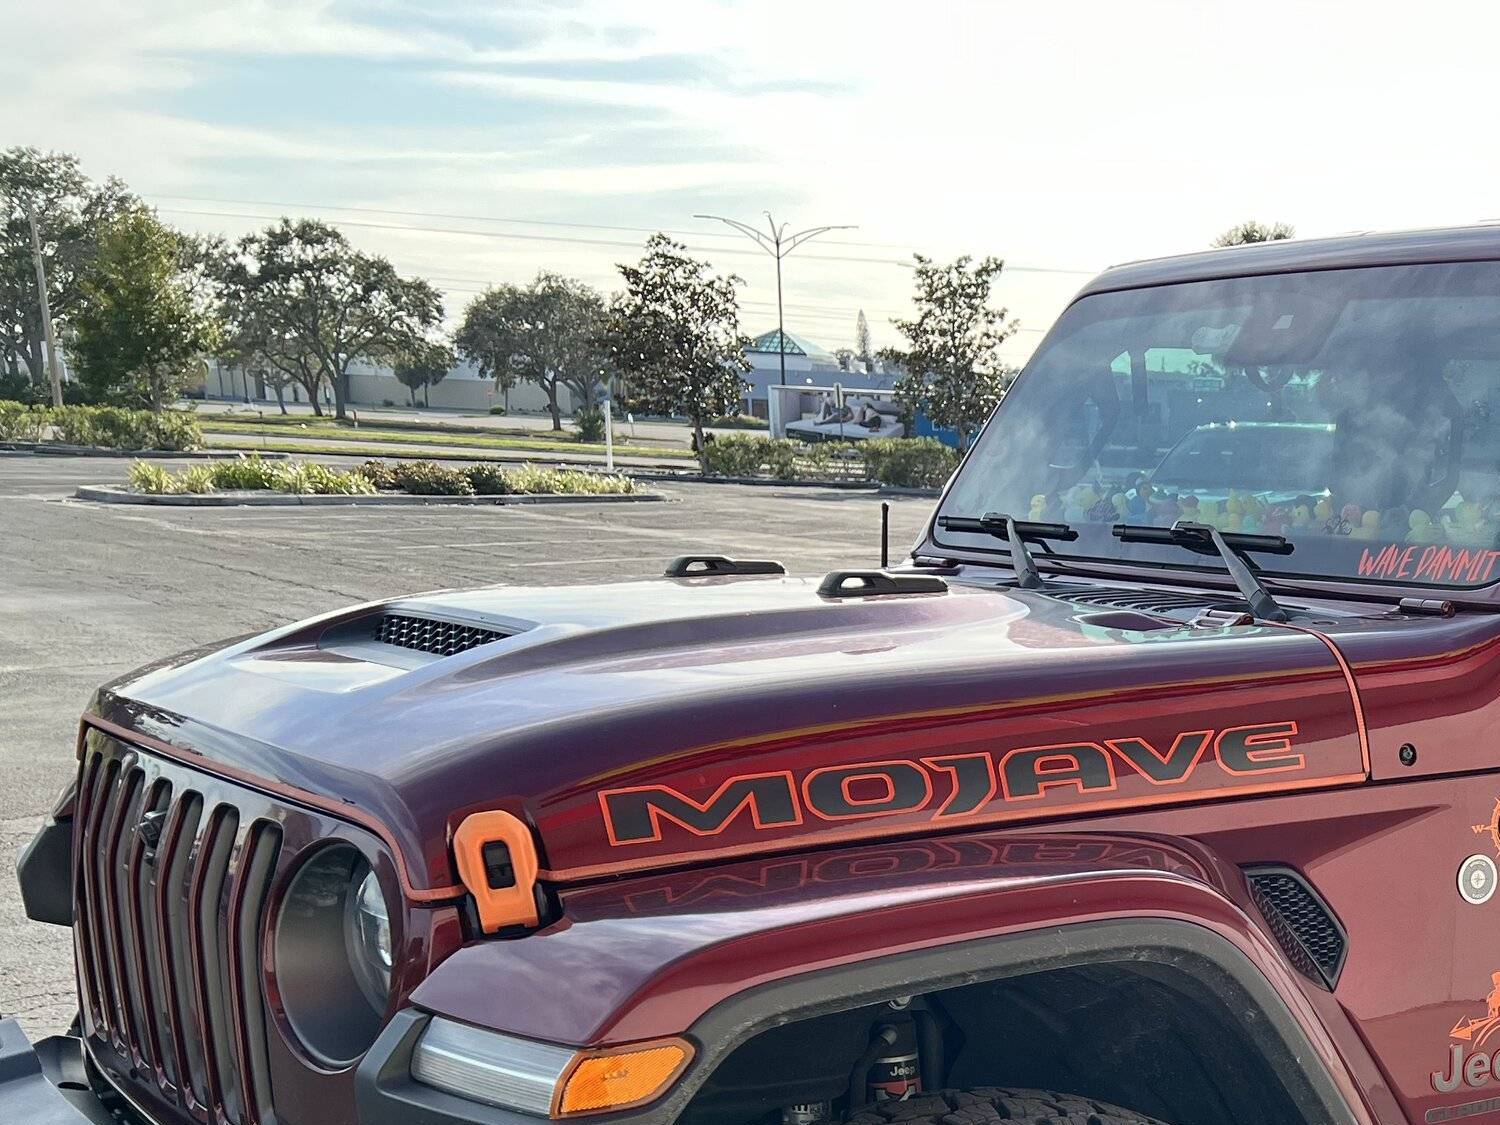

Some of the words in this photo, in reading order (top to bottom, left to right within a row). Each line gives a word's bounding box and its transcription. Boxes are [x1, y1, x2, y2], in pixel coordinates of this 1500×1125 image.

[1358, 543, 1418, 579] WAVE
[598, 721, 1305, 846] MOJAVE
[890, 1065, 915, 1077] Jeep
